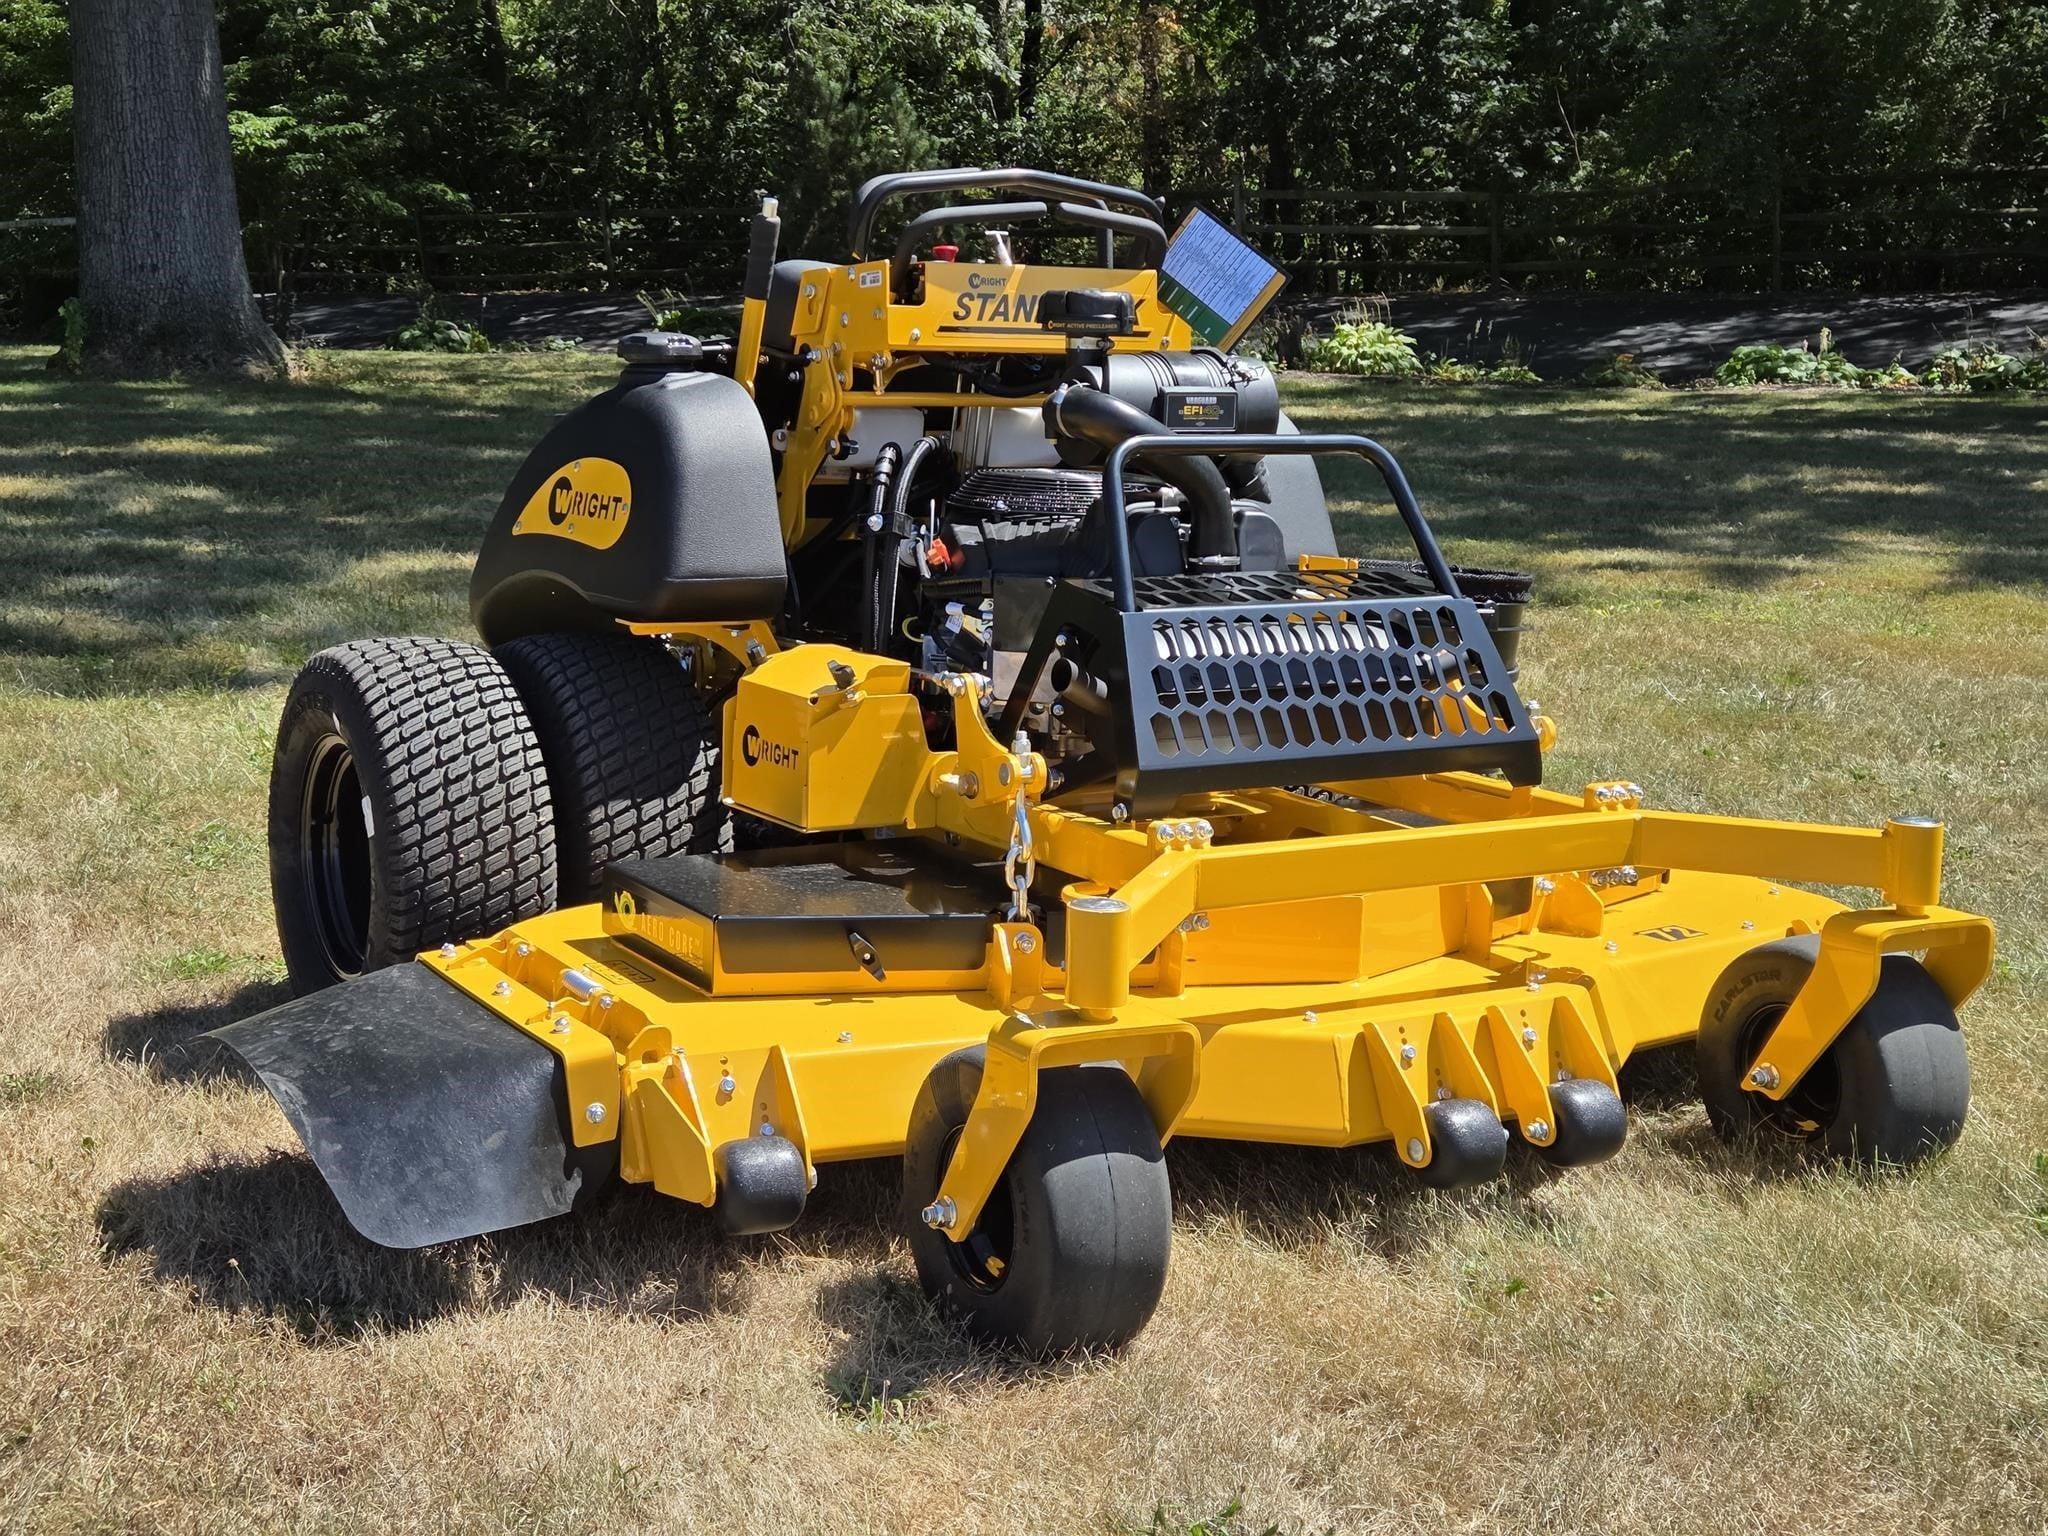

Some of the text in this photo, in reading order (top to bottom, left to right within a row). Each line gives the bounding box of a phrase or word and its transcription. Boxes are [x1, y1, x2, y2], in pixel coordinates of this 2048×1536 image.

[968, 273, 1007, 289] WRIGHT
[548, 475, 623, 526] WRIGHT
[742, 724, 799, 771] WRIGHT
[641, 912, 664, 942] AERO
[1636, 925, 1707, 942] 72
[1713, 968, 1782, 1023] CARLSTAR
